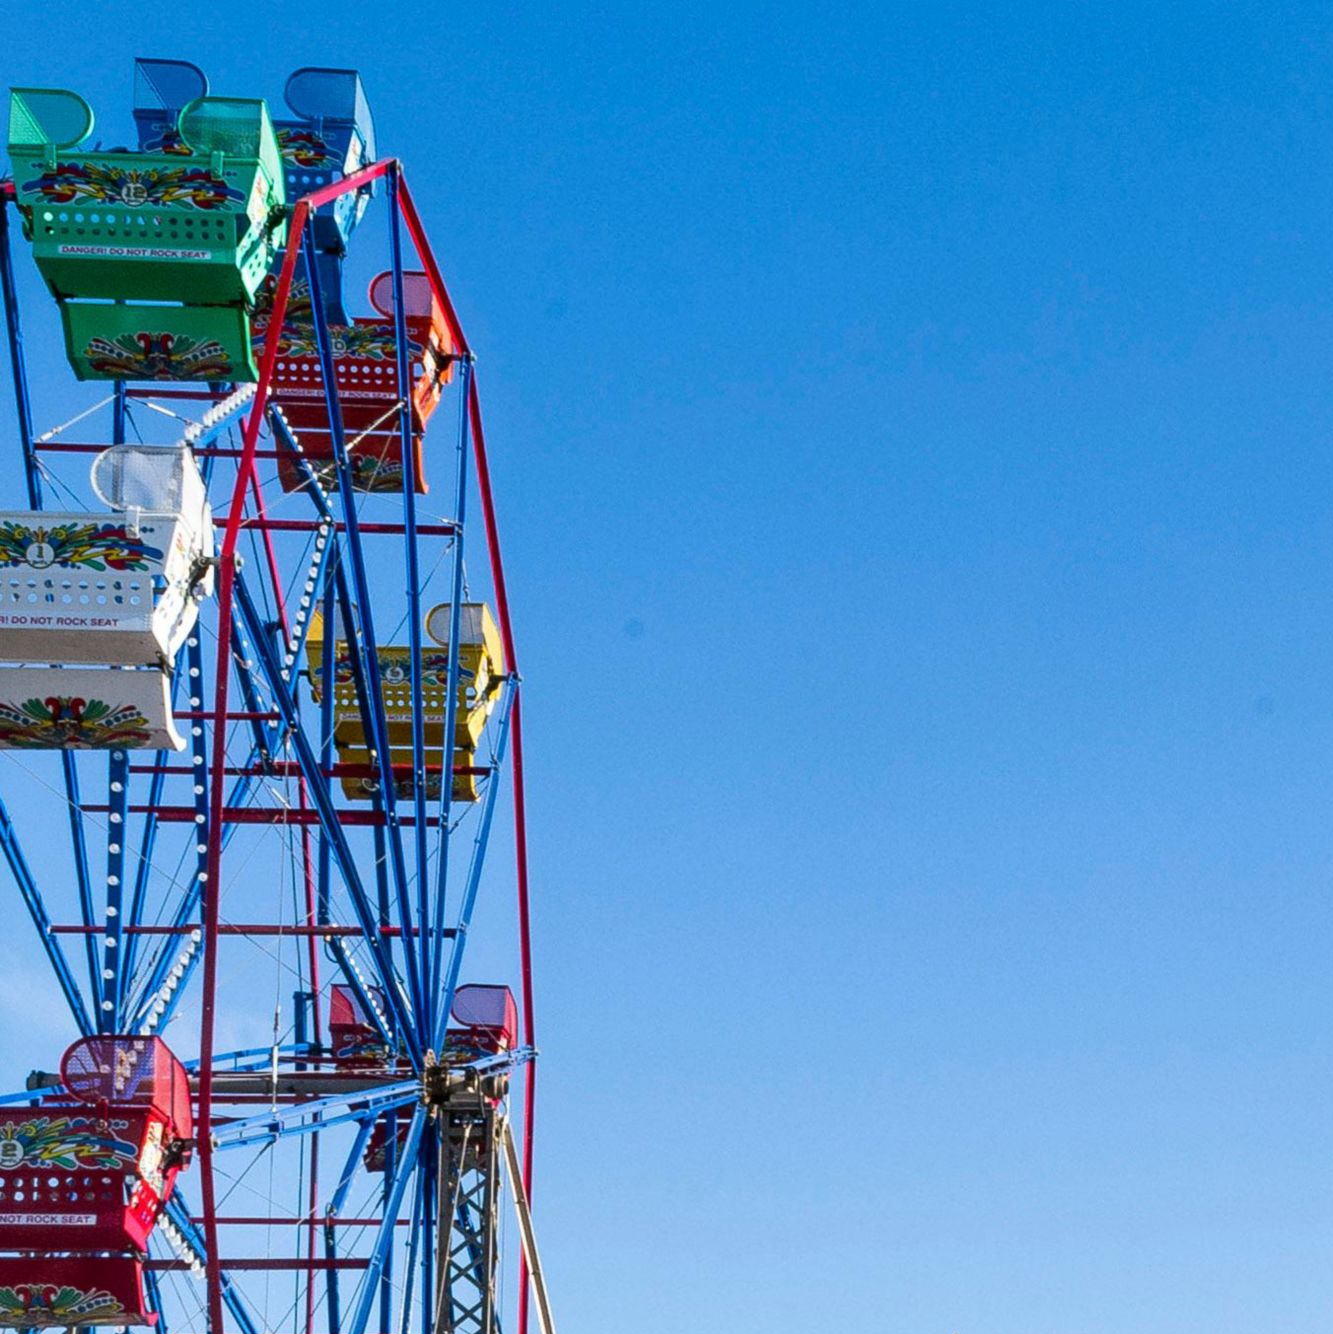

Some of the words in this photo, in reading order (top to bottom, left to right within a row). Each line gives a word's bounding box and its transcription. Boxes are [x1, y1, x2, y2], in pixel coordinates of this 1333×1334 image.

[62, 246, 106, 254] DANGER!
[109, 247, 125, 255] DO
[127, 248, 148, 256] NOT
[150, 249, 178, 258] ROCK
[11, 615, 28, 625] DO
[30, 617, 52, 625] NOT
[56, 617, 87, 626] ROCK
[90, 618, 118, 627] SEAT
[1, 1143, 17, 1158] 2
[0, 1215, 22, 1223] NOT
[26, 1215, 58, 1223] ROCK
[61, 1215, 90, 1223] SEAT
